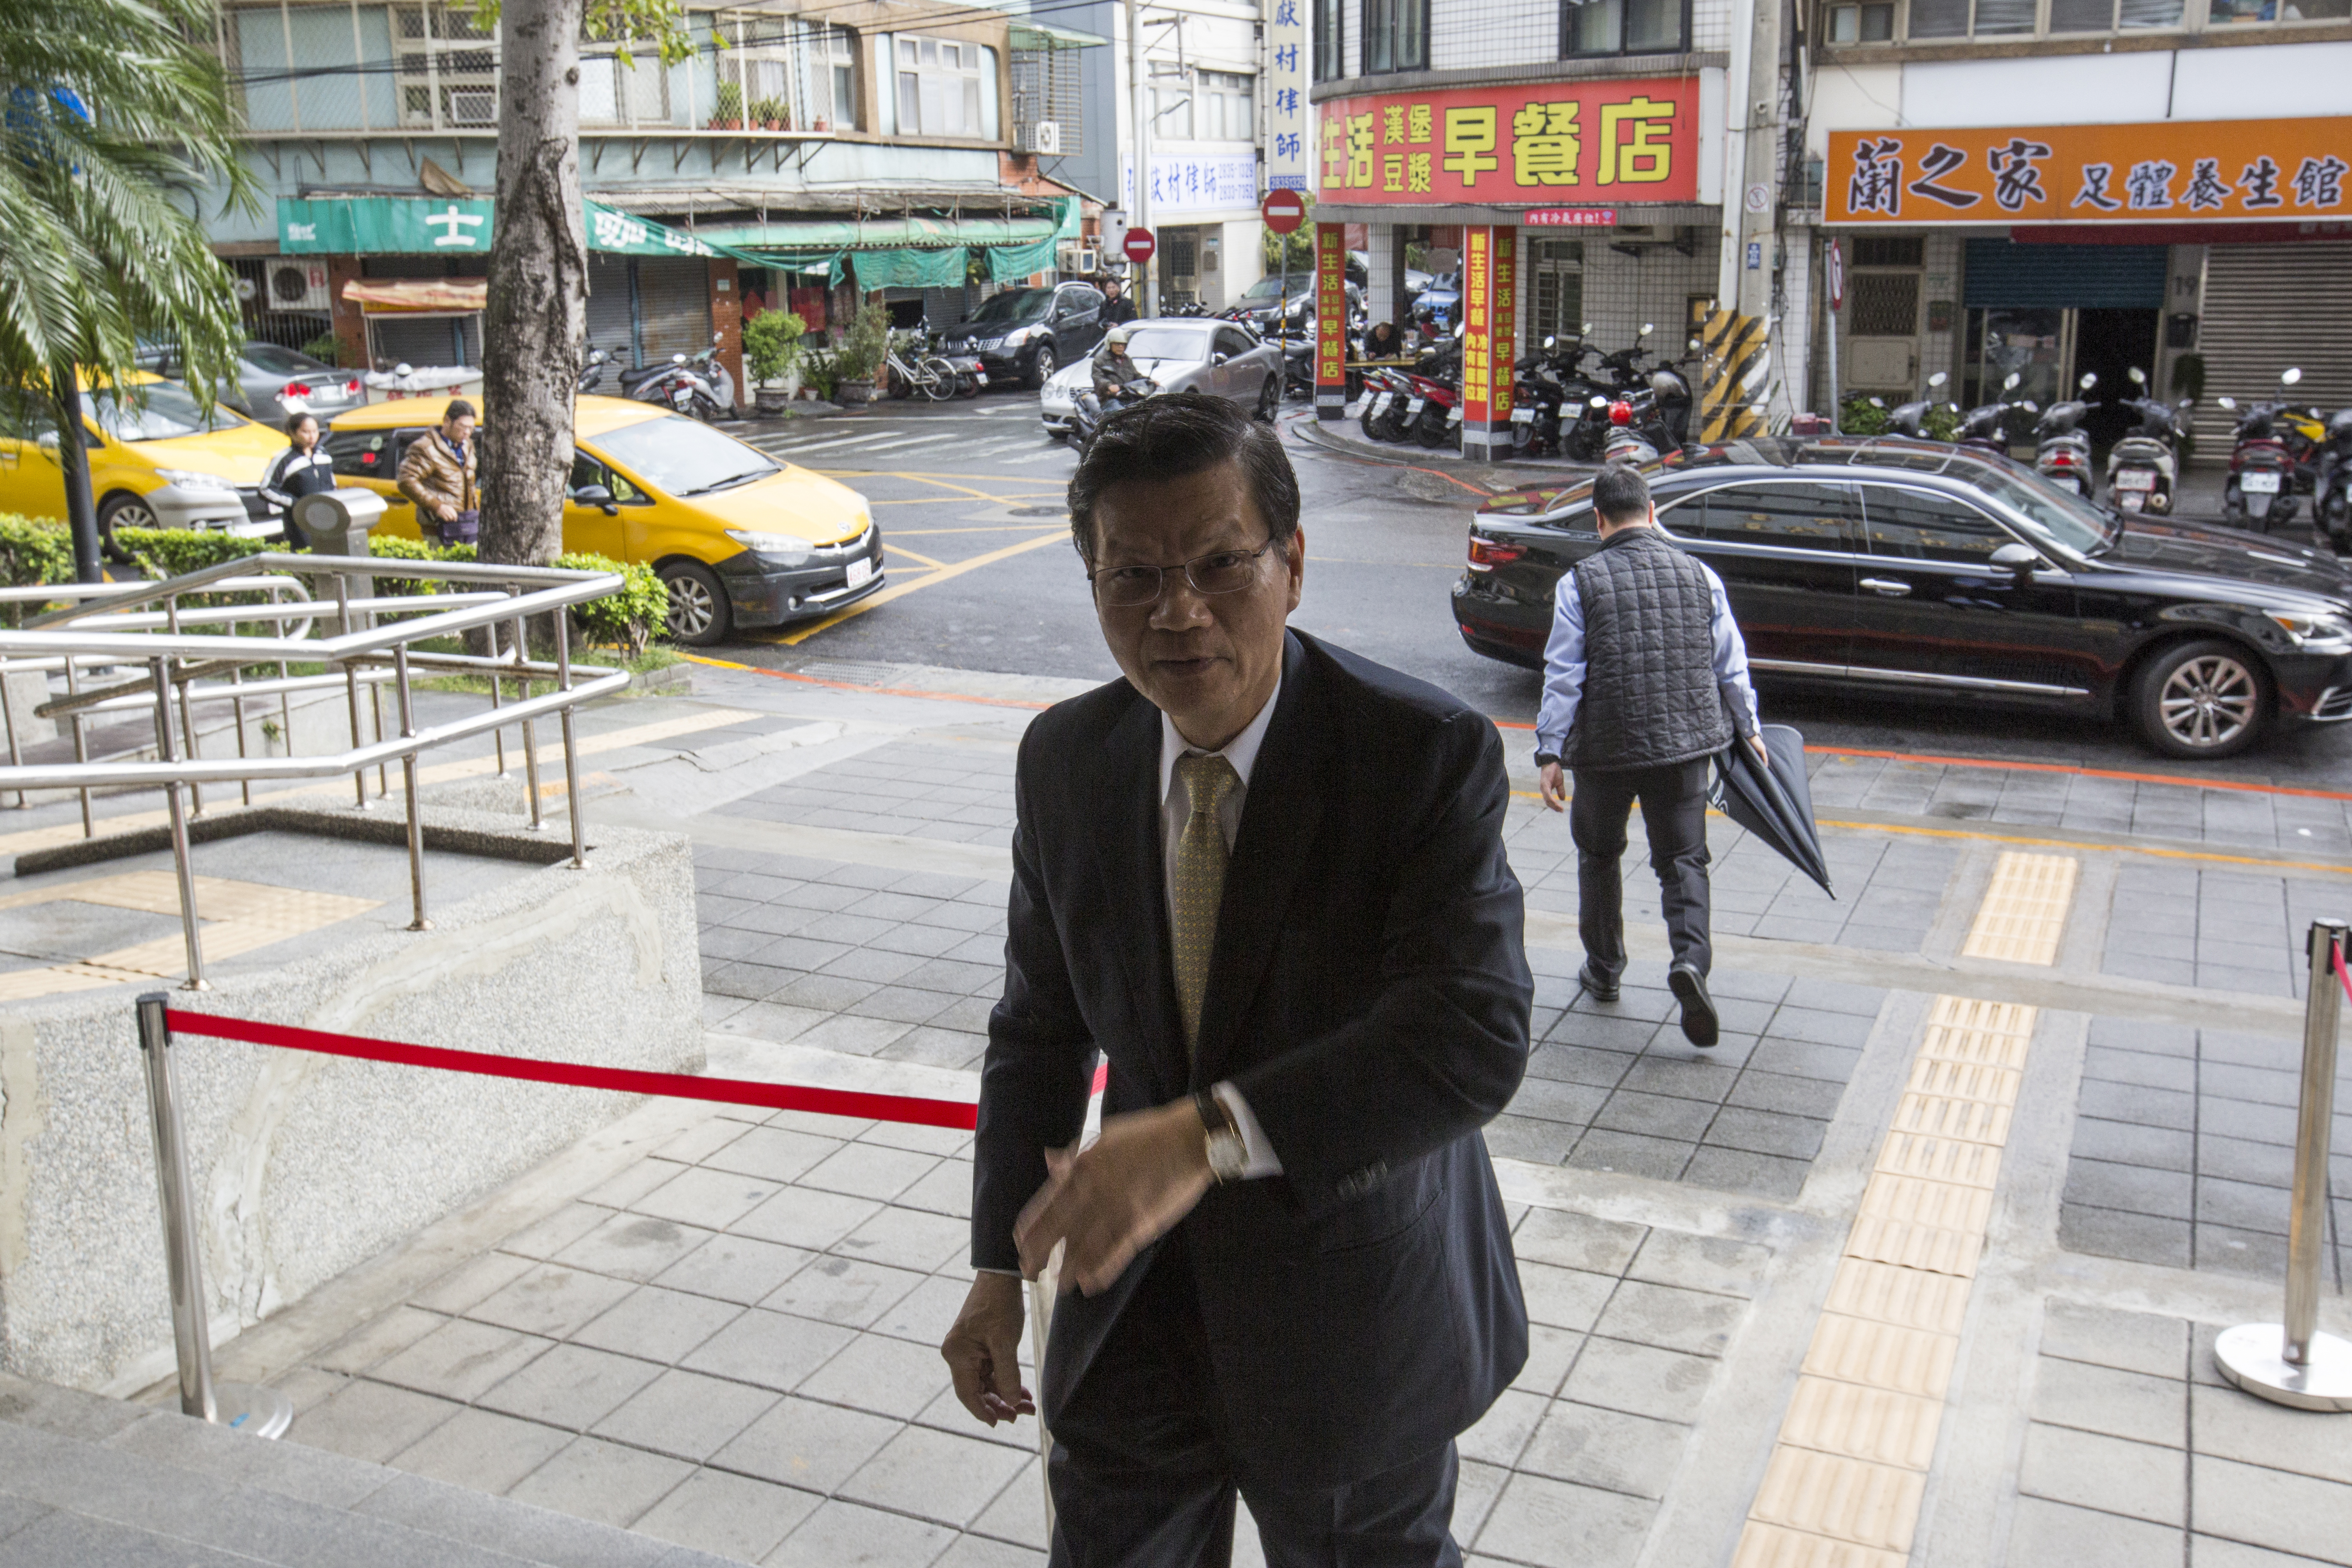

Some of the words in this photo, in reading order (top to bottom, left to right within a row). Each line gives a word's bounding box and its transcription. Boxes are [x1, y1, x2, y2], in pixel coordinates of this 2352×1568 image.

[1383, 103, 1432, 146] 漢堡
[1443, 96, 1676, 188] 早餐店
[1383, 151, 1432, 194] 豆漿
[1847, 136, 2053, 216] 蘭之家
[2070, 155, 2349, 211] 足體養生館
